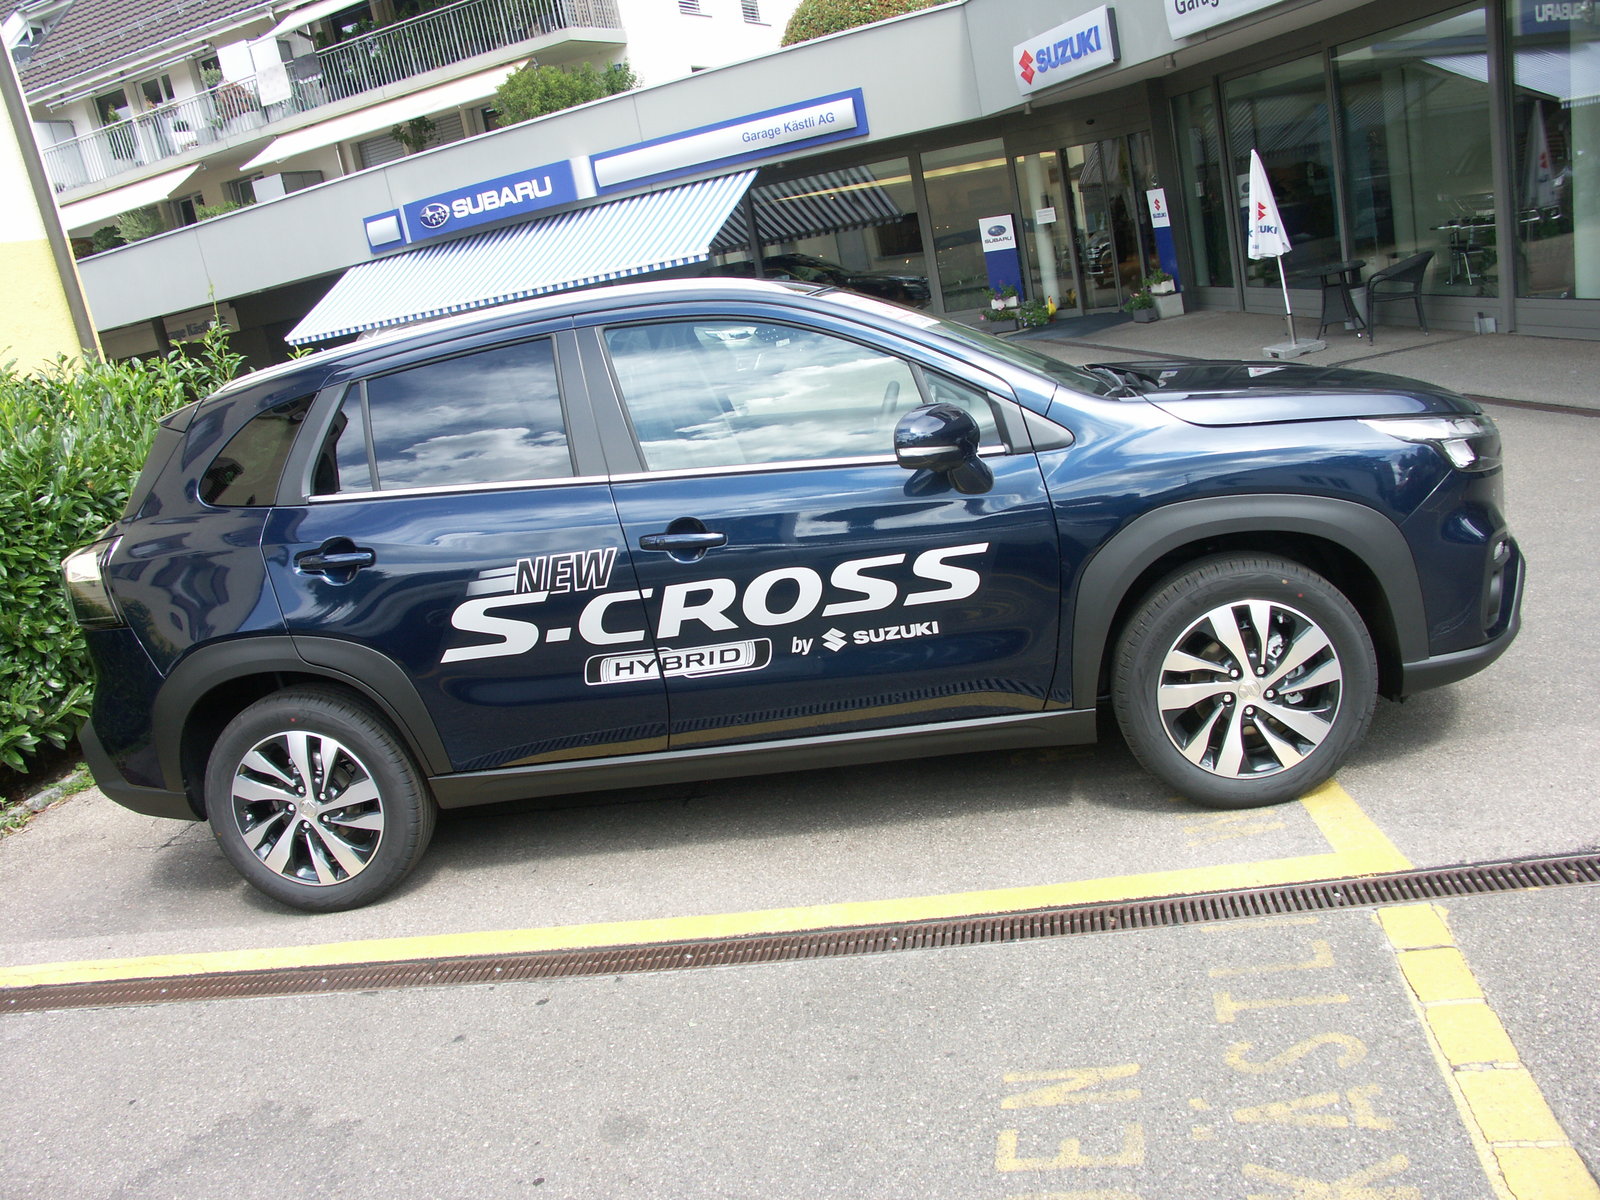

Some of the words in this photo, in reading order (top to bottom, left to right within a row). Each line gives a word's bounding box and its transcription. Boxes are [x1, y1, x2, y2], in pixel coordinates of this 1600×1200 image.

[1035, 25, 1102, 74] SUZUKI
[742, 126, 781, 143] Garage
[783, 116, 815, 133] Kästli
[818, 112, 835, 125] AG
[451, 175, 553, 219] SUBARU
[984, 235, 1013, 244] SUBARU
[1257, 224, 1278, 235] UKI
[514, 547, 618, 594] NEW
[440, 542, 989, 663] S-CROSS
[791, 636, 814, 655] by
[853, 620, 940, 645] SUZUKI
[614, 647, 741, 678] HYBRID
